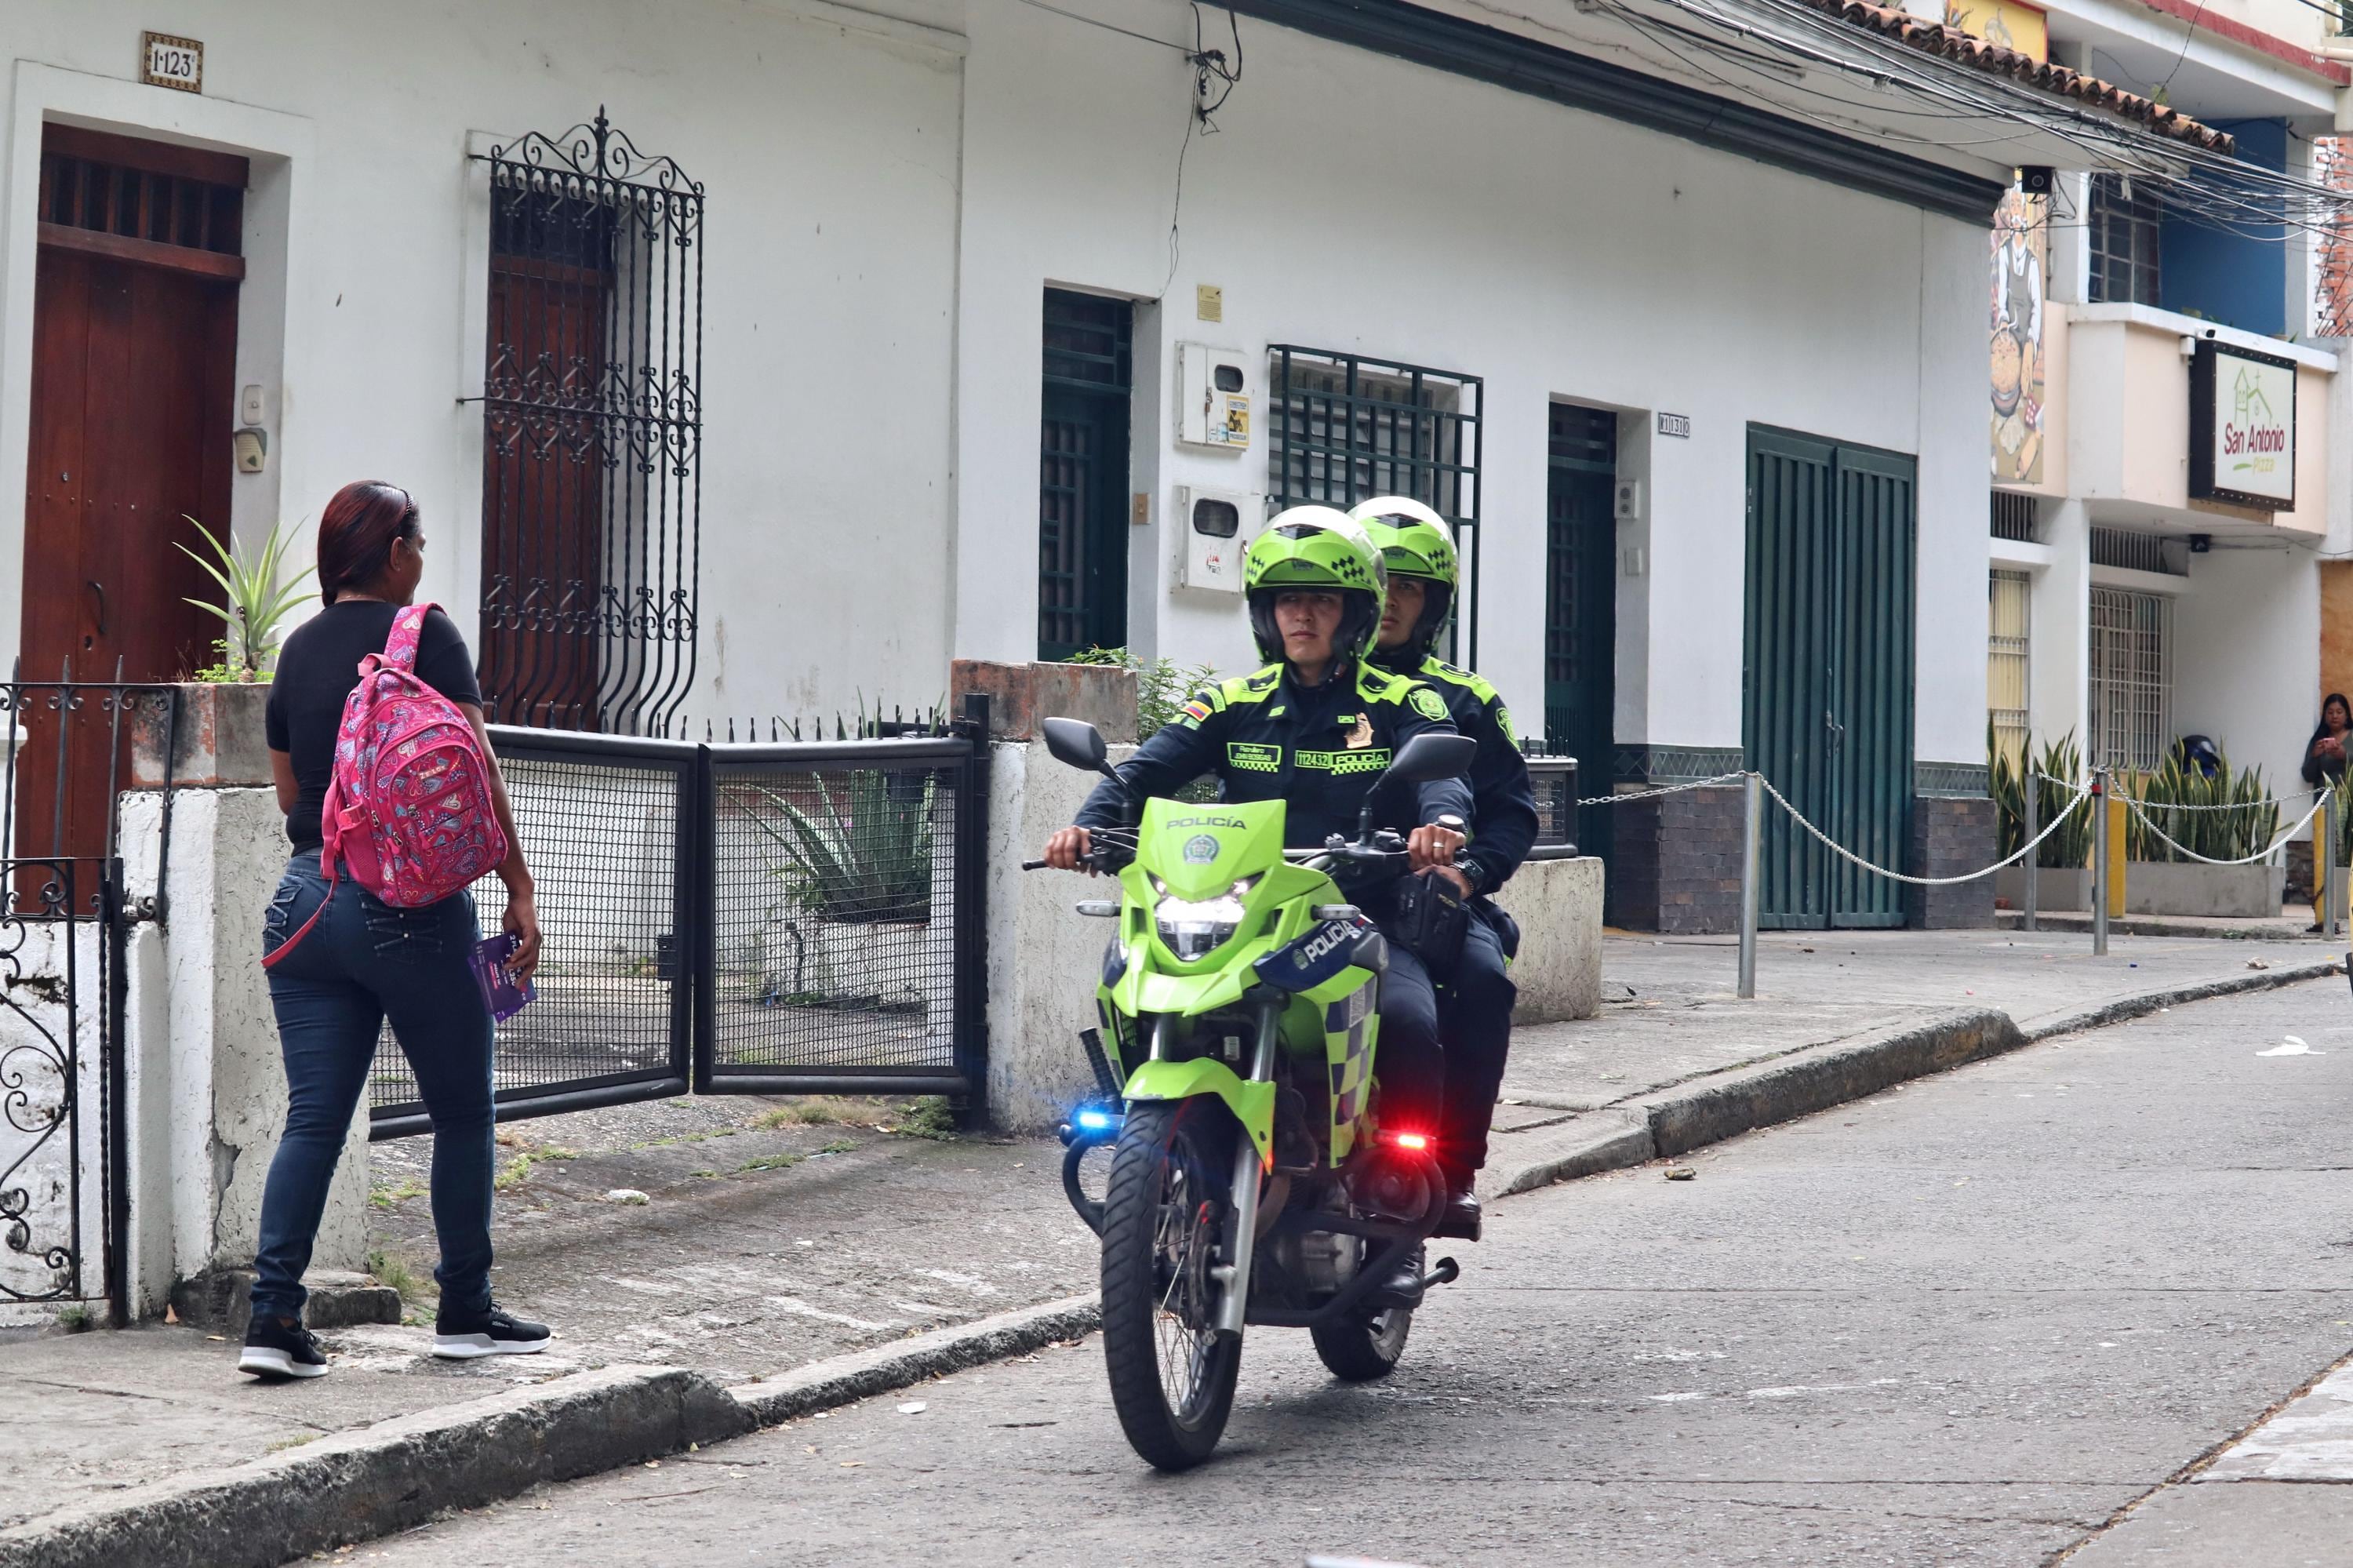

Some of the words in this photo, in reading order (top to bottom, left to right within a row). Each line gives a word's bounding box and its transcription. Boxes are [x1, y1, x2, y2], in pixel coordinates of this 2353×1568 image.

[2224, 422, 2245, 455] San
[2247, 424, 2285, 453] Antonio
[1298, 753, 1328, 766] 112432
[1336, 752, 1385, 764] POLICÍA
[1166, 816, 1247, 830] POLICÍA
